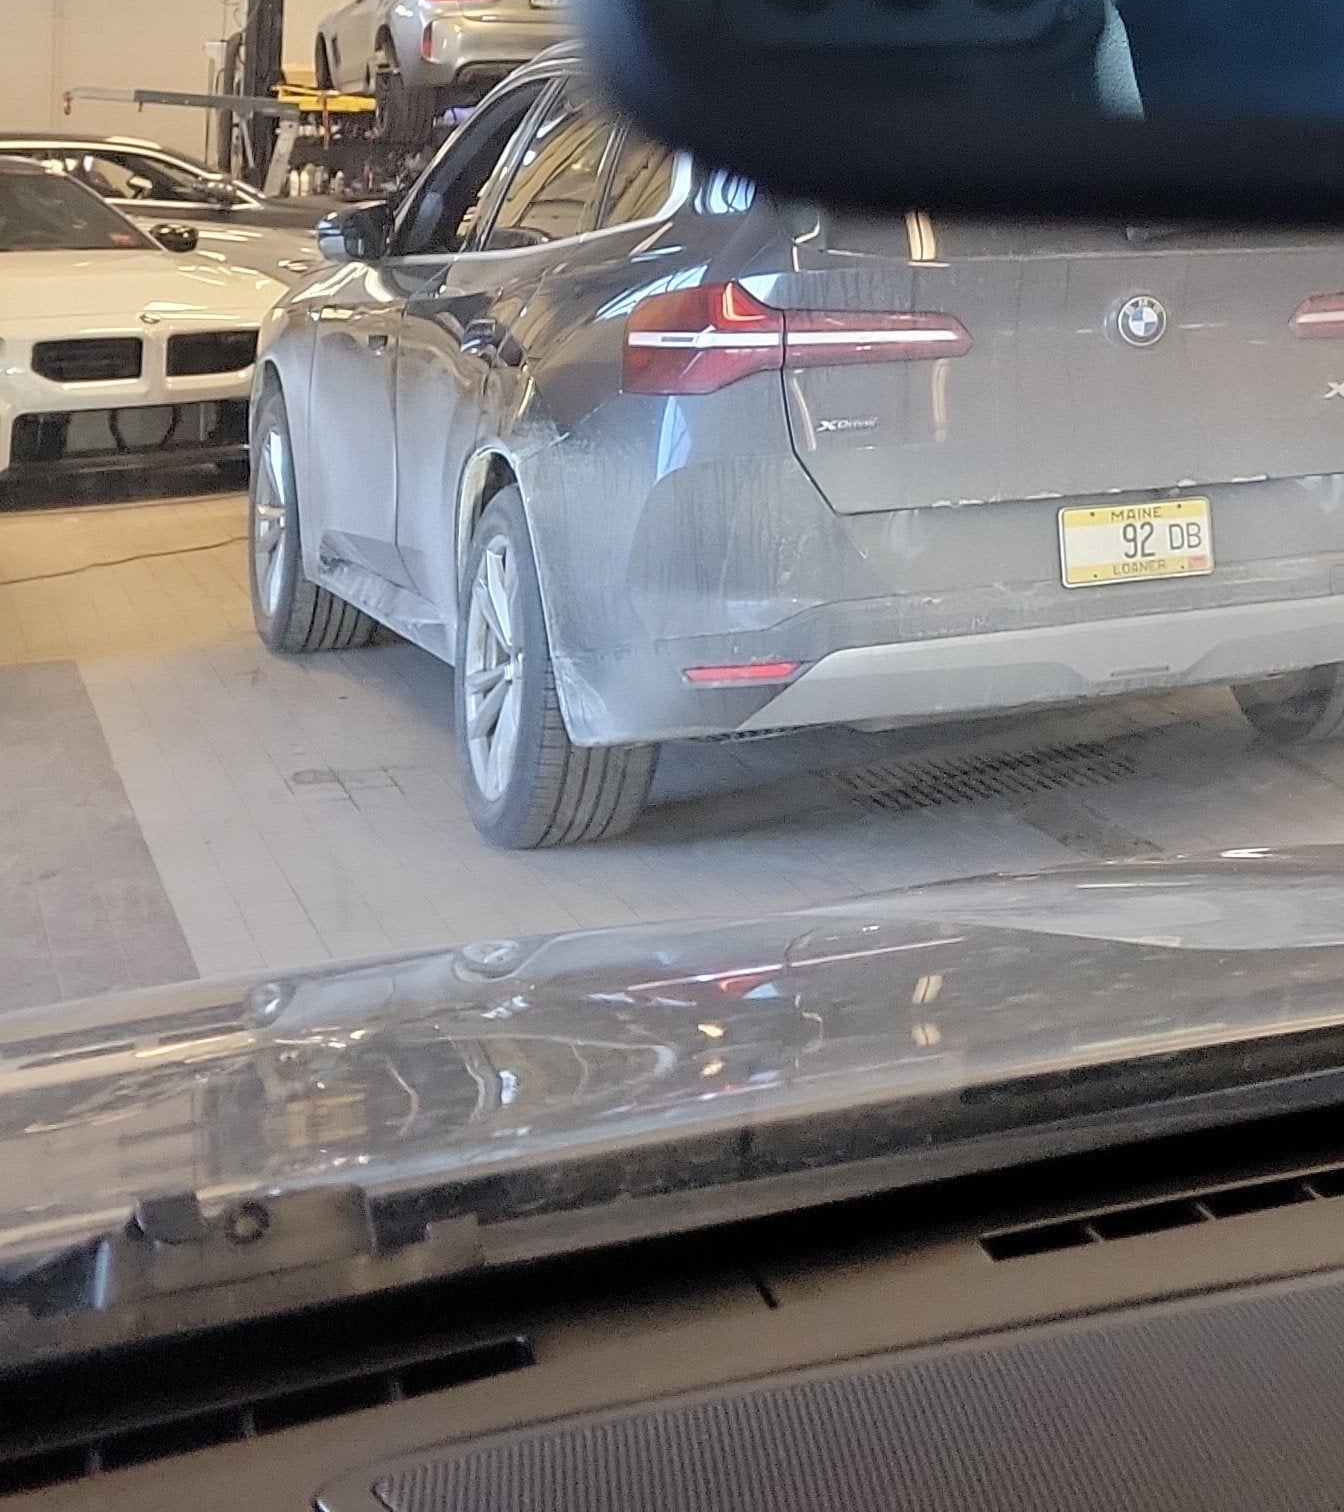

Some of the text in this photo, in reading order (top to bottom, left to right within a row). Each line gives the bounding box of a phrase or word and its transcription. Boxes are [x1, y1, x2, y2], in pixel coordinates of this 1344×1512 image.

[1110, 506, 1163, 523] MAINE
[1122, 522, 1202, 559] 92 DB
[1112, 559, 1166, 576] LOANER
